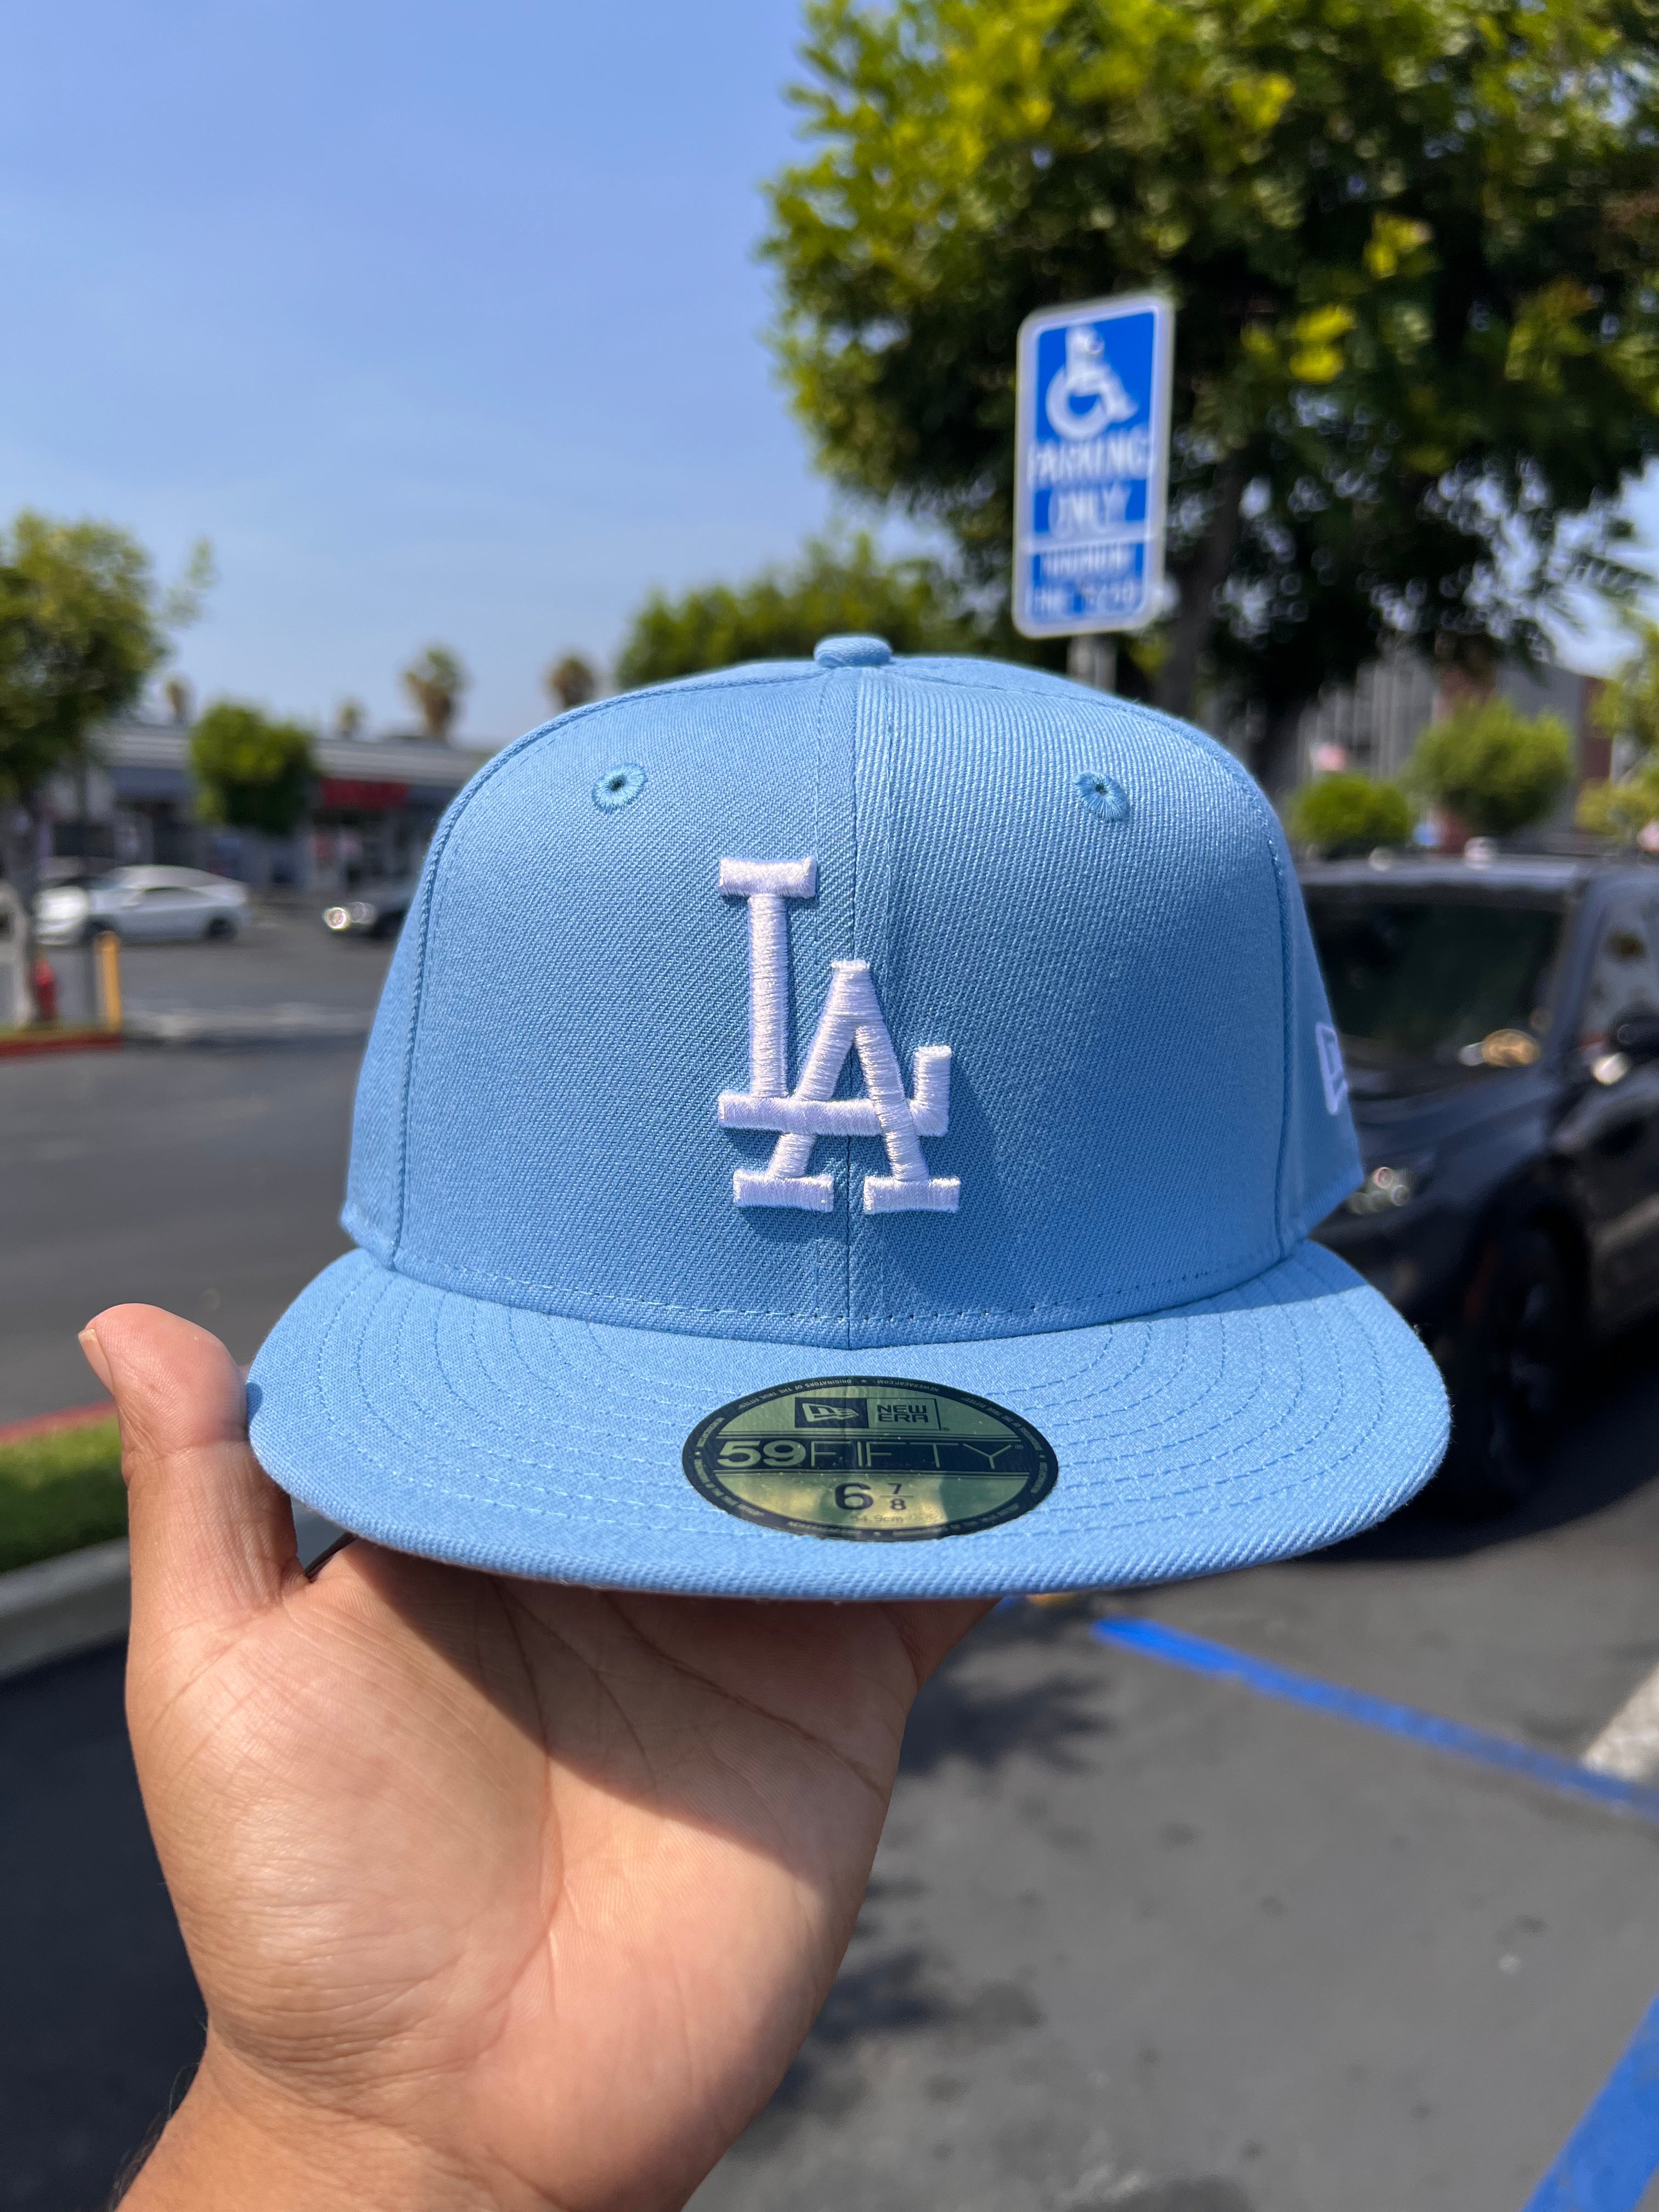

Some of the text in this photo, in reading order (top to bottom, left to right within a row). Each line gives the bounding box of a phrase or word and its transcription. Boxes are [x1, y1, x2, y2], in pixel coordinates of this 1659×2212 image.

[1027, 425, 1152, 486] PARKING
[1049, 483, 1131, 537] ONLY
[719, 856, 961, 1214] LA
[804, 1379, 852, 1388] ORIGINATORS
[877, 1404, 927, 1414] NEW
[878, 1414, 929, 1423] ERA
[716, 1440, 1013, 1469] 59FIFTY
[835, 1482, 874, 1510] 6
